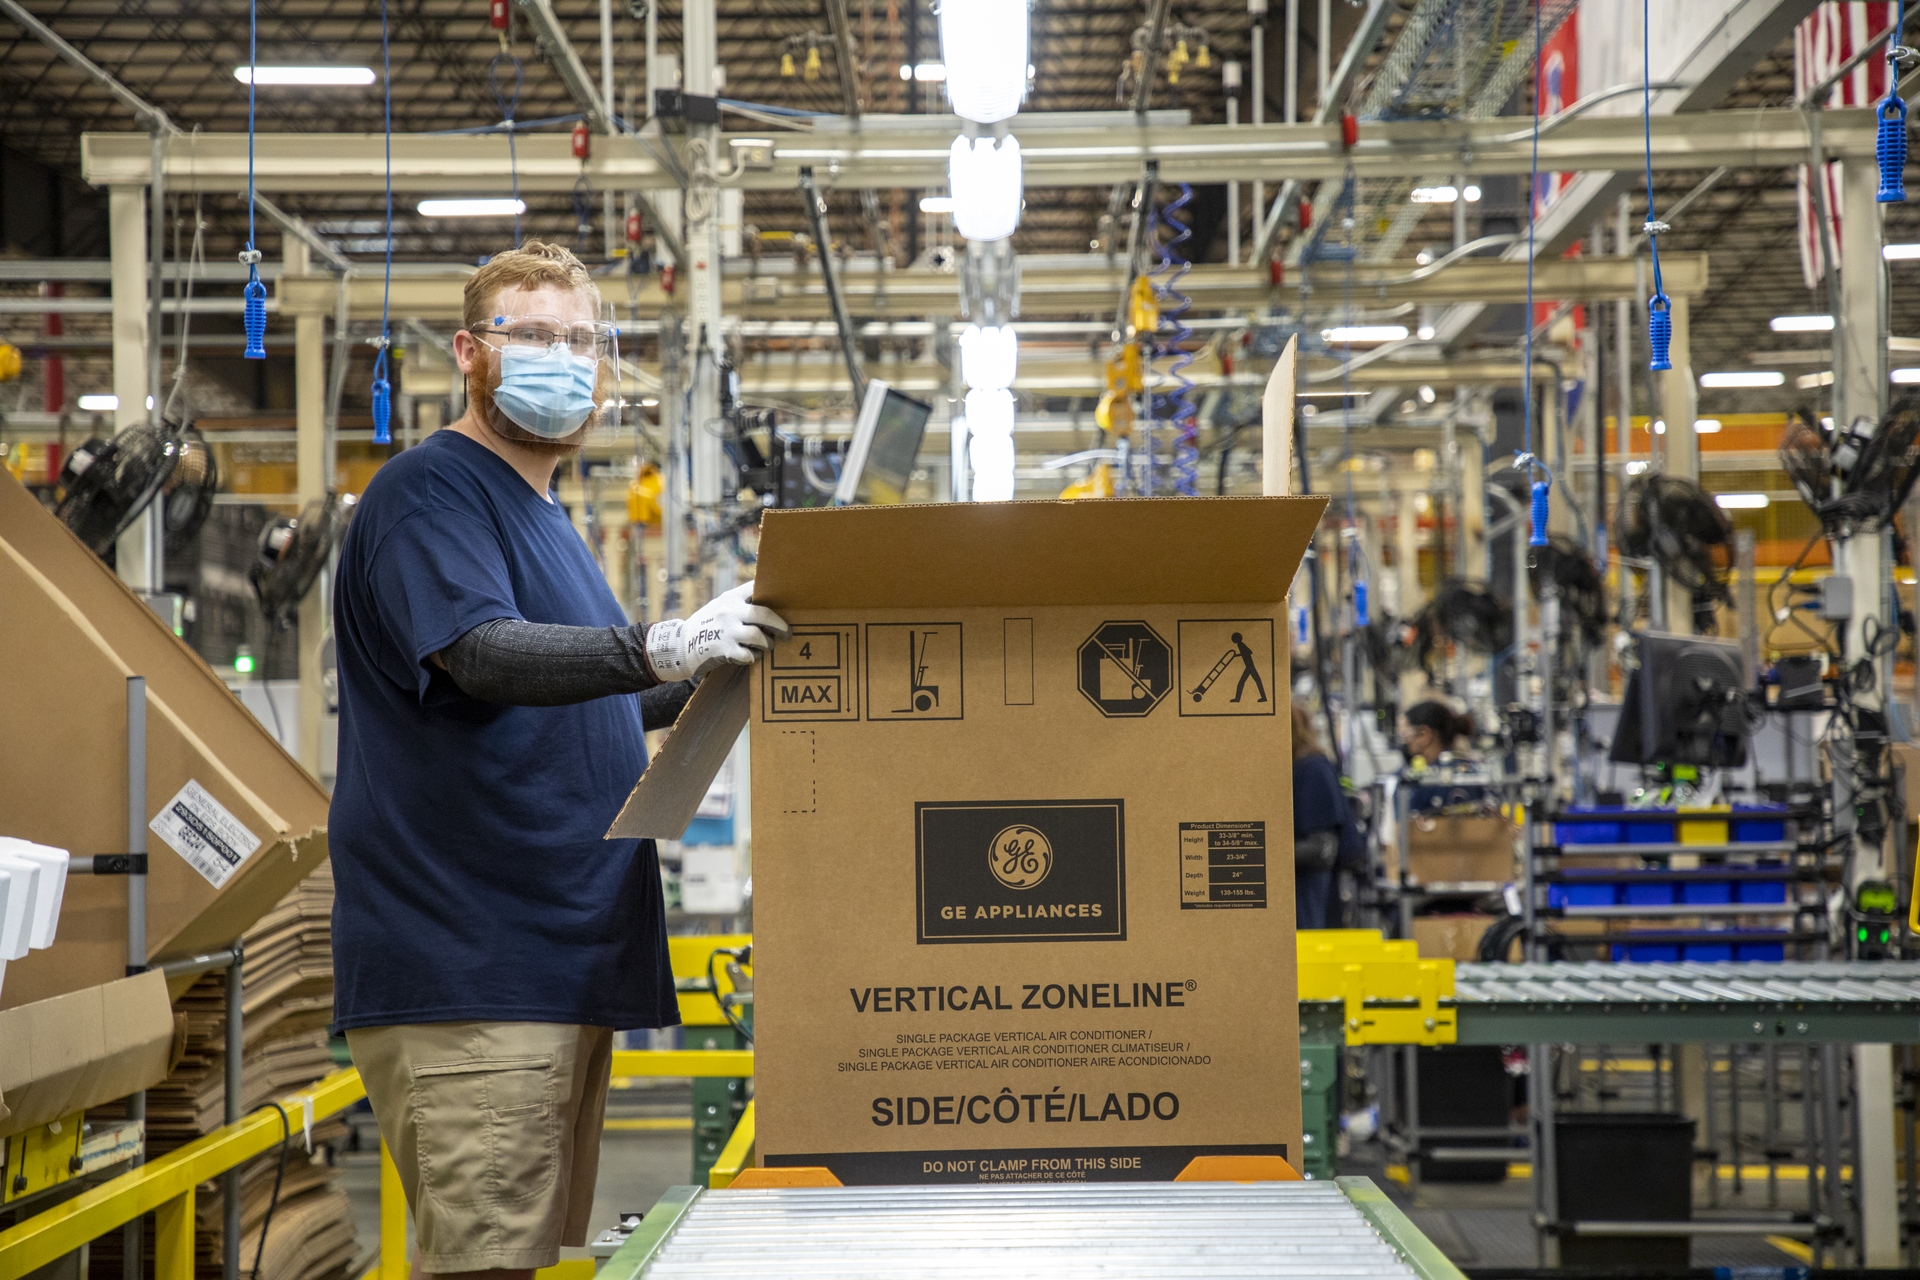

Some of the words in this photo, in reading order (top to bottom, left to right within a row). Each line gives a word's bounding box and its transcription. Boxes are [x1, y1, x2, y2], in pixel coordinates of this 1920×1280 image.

[799, 642, 812, 660] 4
[781, 685, 832, 703] MAX
[1184, 836, 1204, 844] Height
[940, 906, 967, 920] GE
[974, 903, 1103, 919] APPLIANCES
[850, 985, 1013, 1013] VERTICAL
[896, 1034, 936, 1044] SINGLE
[939, 1032, 991, 1043] PACKAGE
[994, 1032, 1047, 1042] VERTICAL
[1048, 1031, 1067, 1041] AIR
[1070, 1030, 1146, 1040] CONDITIONER
[858, 1048, 899, 1058] SINGLE
[902, 1046, 954, 1057] PACKAGE
[956, 1045, 1009, 1056] VERTICAL
[1011, 1045, 1030, 1055] AIR
[1032, 1044, 1109, 1054] CONDITIONER
[1111, 1042, 1184, 1053] CLIMATISEUR
[837, 1062, 878, 1072] SINGLE
[881, 1060, 933, 1071] PACKAGE
[935, 1059, 989, 1070] VERTICAL
[990, 1059, 1009, 1069] AIR
[1012, 1057, 1088, 1068] CONDITIONER
[1090, 1057, 1116, 1067] AIRE
[1118, 1055, 1211, 1066] ACONDICIONADO
[871, 1086, 1180, 1127] SIDE/CÔTÉ/LADO
[923, 1161, 944, 1173] DO
[947, 1161, 976, 1173] NOT
[979, 1159, 1028, 1172] CLAMP
[1031, 1158, 1071, 1171] FROM
[1075, 1158, 1106, 1170] THIS
[1110, 1157, 1142, 1169] SIDE
[1066, 1170, 1086, 1178] CÔTÉ
